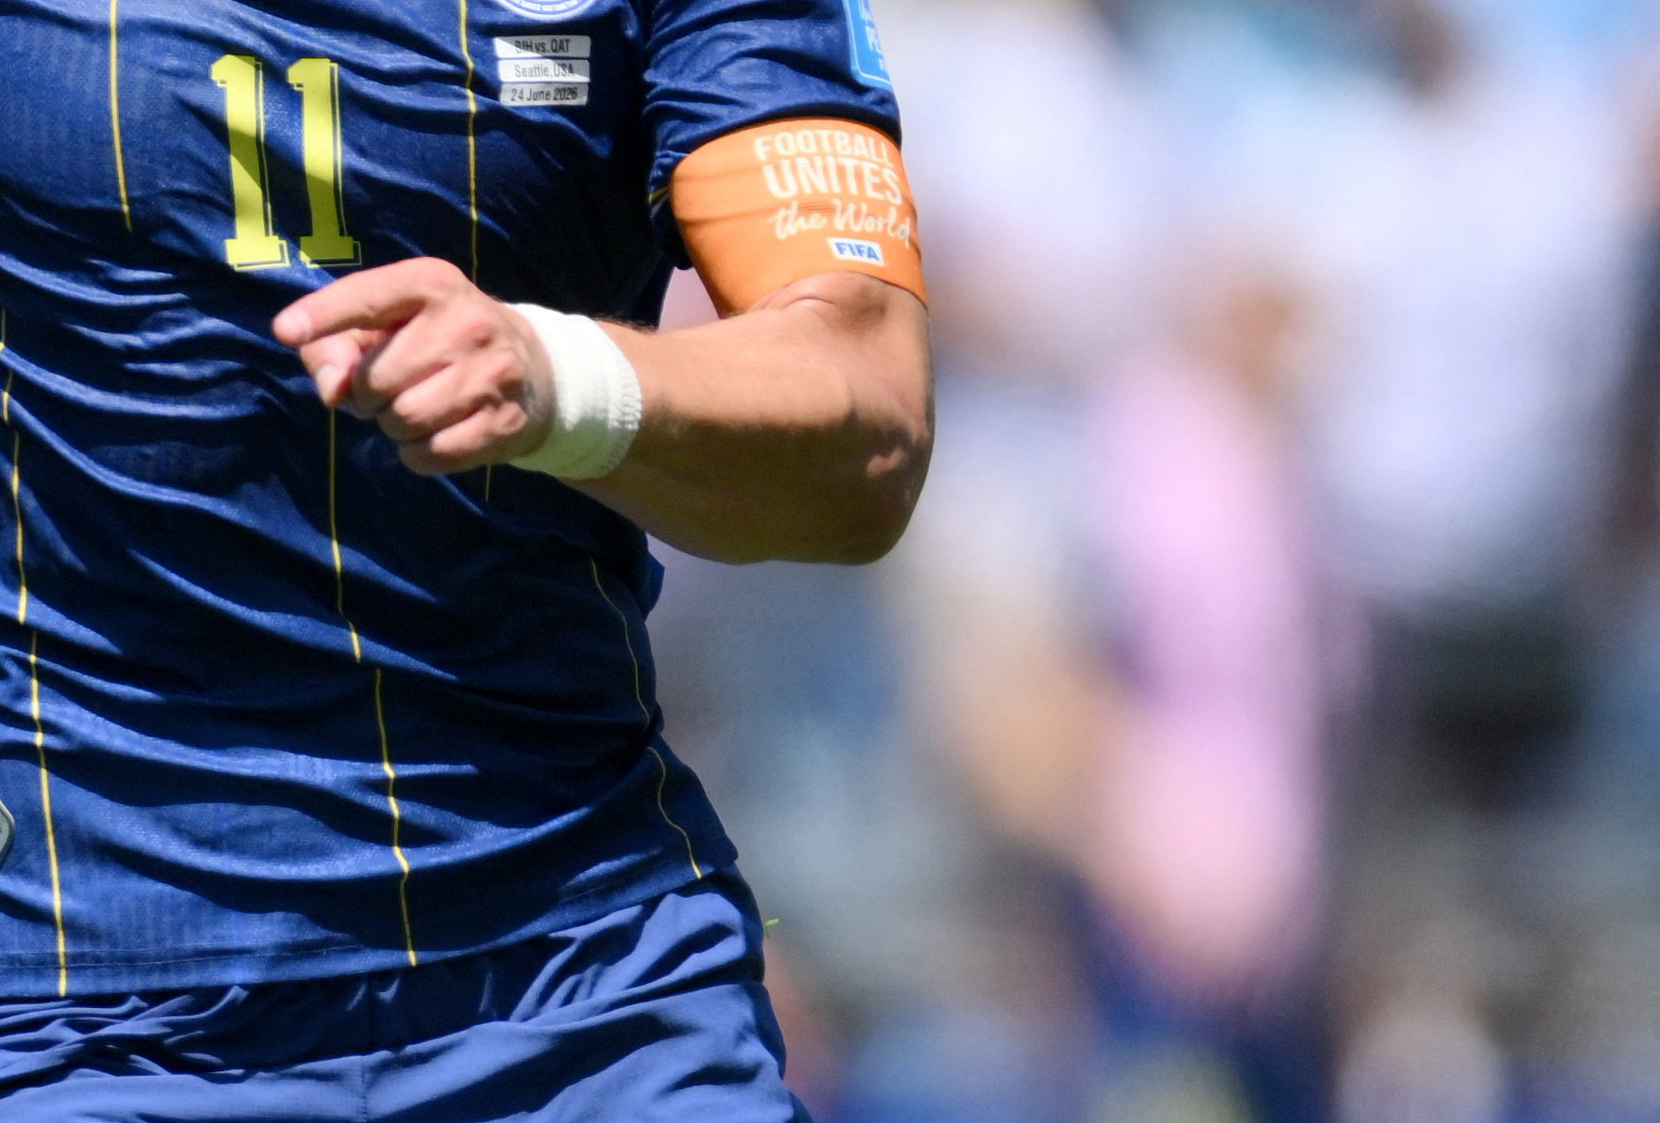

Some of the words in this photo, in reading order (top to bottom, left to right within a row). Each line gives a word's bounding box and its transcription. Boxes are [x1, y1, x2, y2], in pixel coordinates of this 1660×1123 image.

[515, 40, 533, 53] BIH
[534, 42, 550, 53] vs.
[551, 39, 571, 53] QAT
[511, 88, 523, 101] 24
[527, 88, 550, 101] June
[553, 87, 577, 100] 2026
[210, 54, 363, 272] 11
[753, 129, 895, 169] FOOTBALL
[762, 155, 903, 205] UNITES
[767, 200, 828, 240] the
[832, 198, 911, 250] World
[835, 242, 881, 262] FIFA
